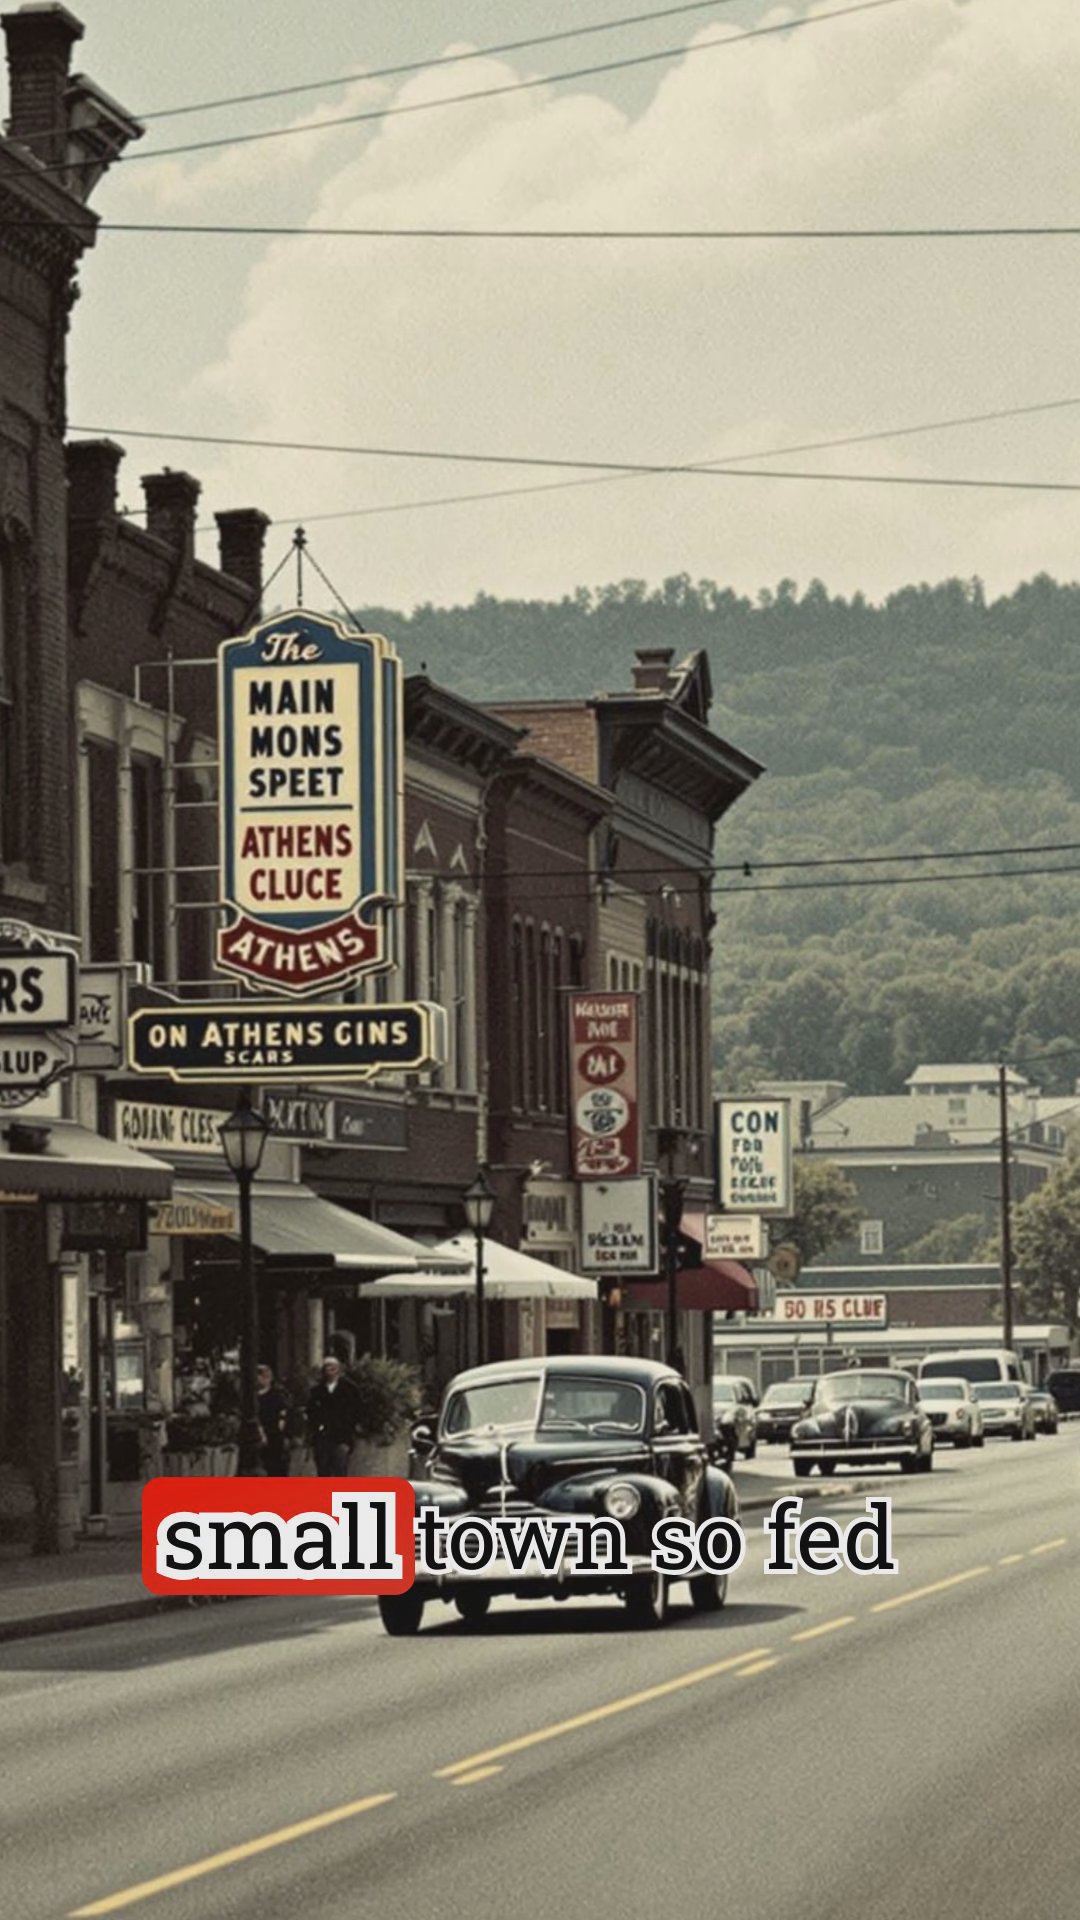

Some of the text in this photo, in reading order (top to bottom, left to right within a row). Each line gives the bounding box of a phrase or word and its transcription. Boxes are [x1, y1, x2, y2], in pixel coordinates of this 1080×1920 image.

[261, 631, 323, 662] The
[249, 678, 335, 715] MAIN
[250, 724, 342, 758] MONS
[249, 766, 344, 798] SPEET
[241, 823, 352, 859] ATHENS
[249, 868, 343, 901] CLUCE
[228, 928, 366, 972] ATHENS
[148, 1024, 188, 1048] ON
[200, 1021, 324, 1048] ATHENS
[223, 1050, 294, 1065] SCARS
[730, 1111, 779, 1134] CON
